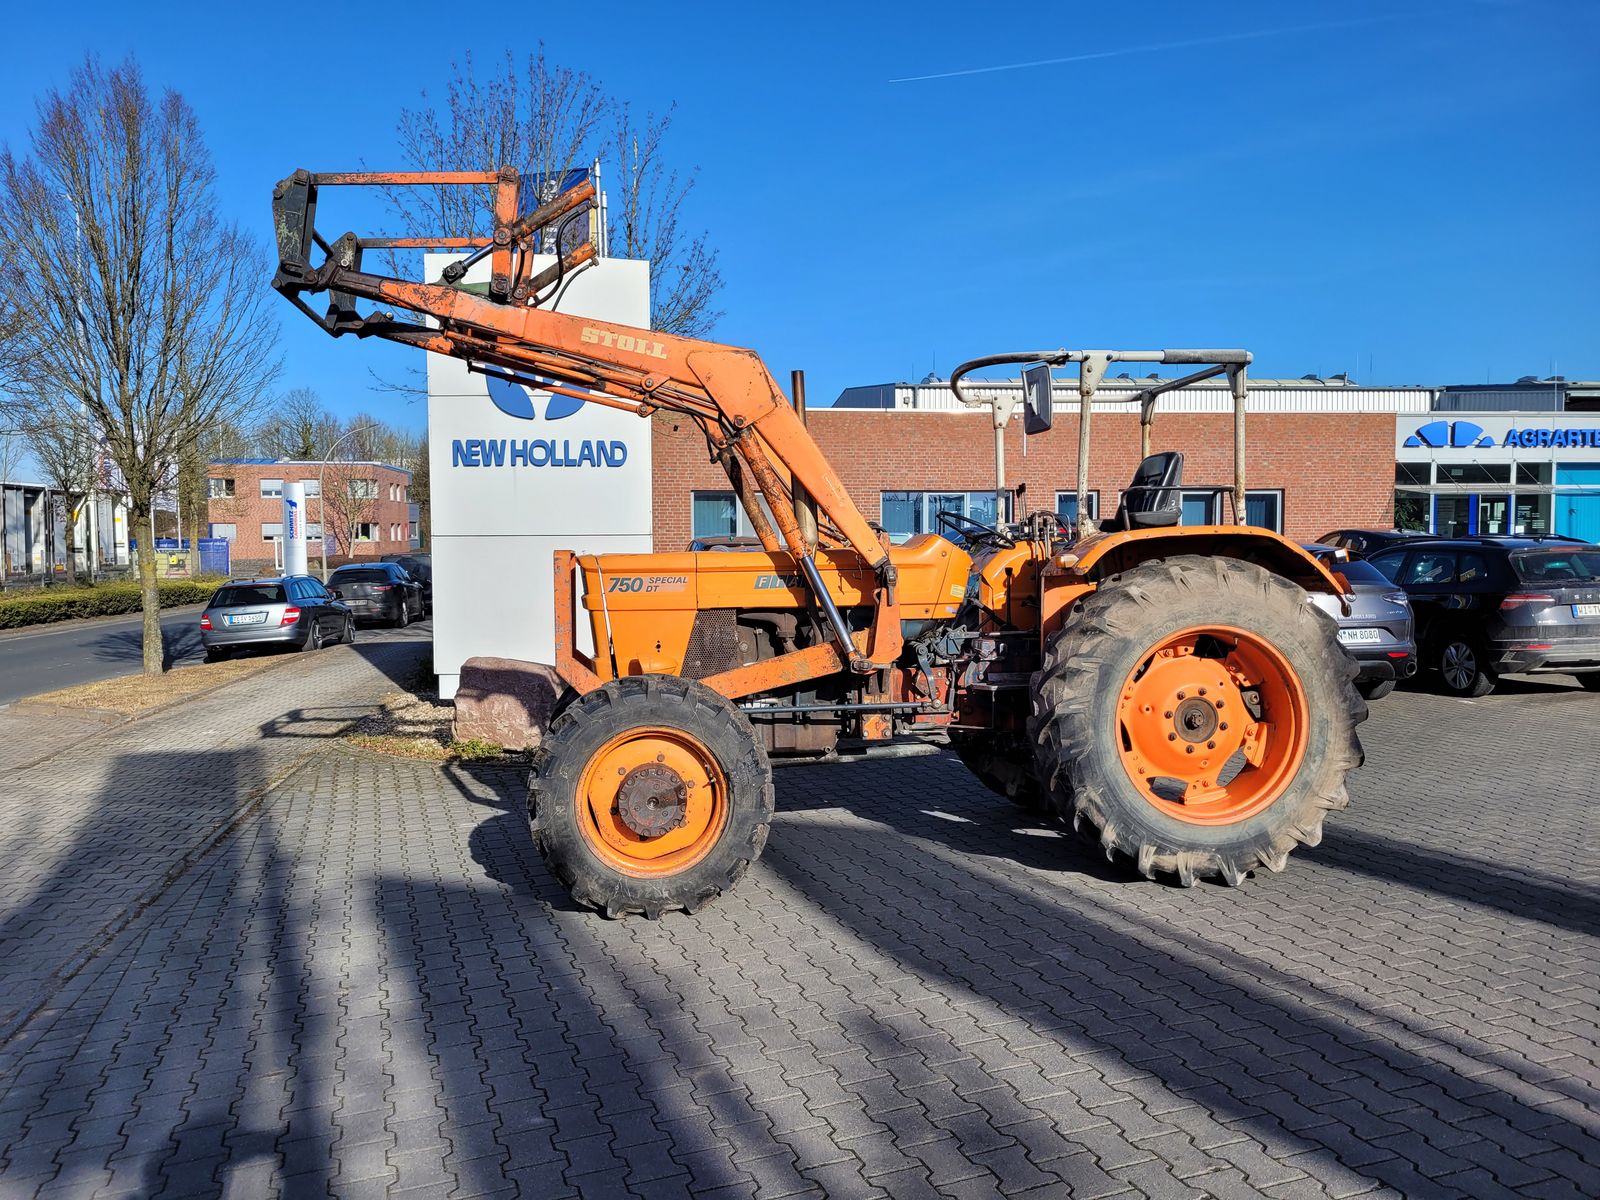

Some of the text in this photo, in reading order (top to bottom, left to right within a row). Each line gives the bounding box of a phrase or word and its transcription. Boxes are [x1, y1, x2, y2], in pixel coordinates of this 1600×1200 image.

[580, 326, 668, 360] STOLL
[452, 438, 628, 468] NEW HOLLAND
[608, 576, 688, 593] 750 SPECIAL
[645, 585, 659, 593] DT
